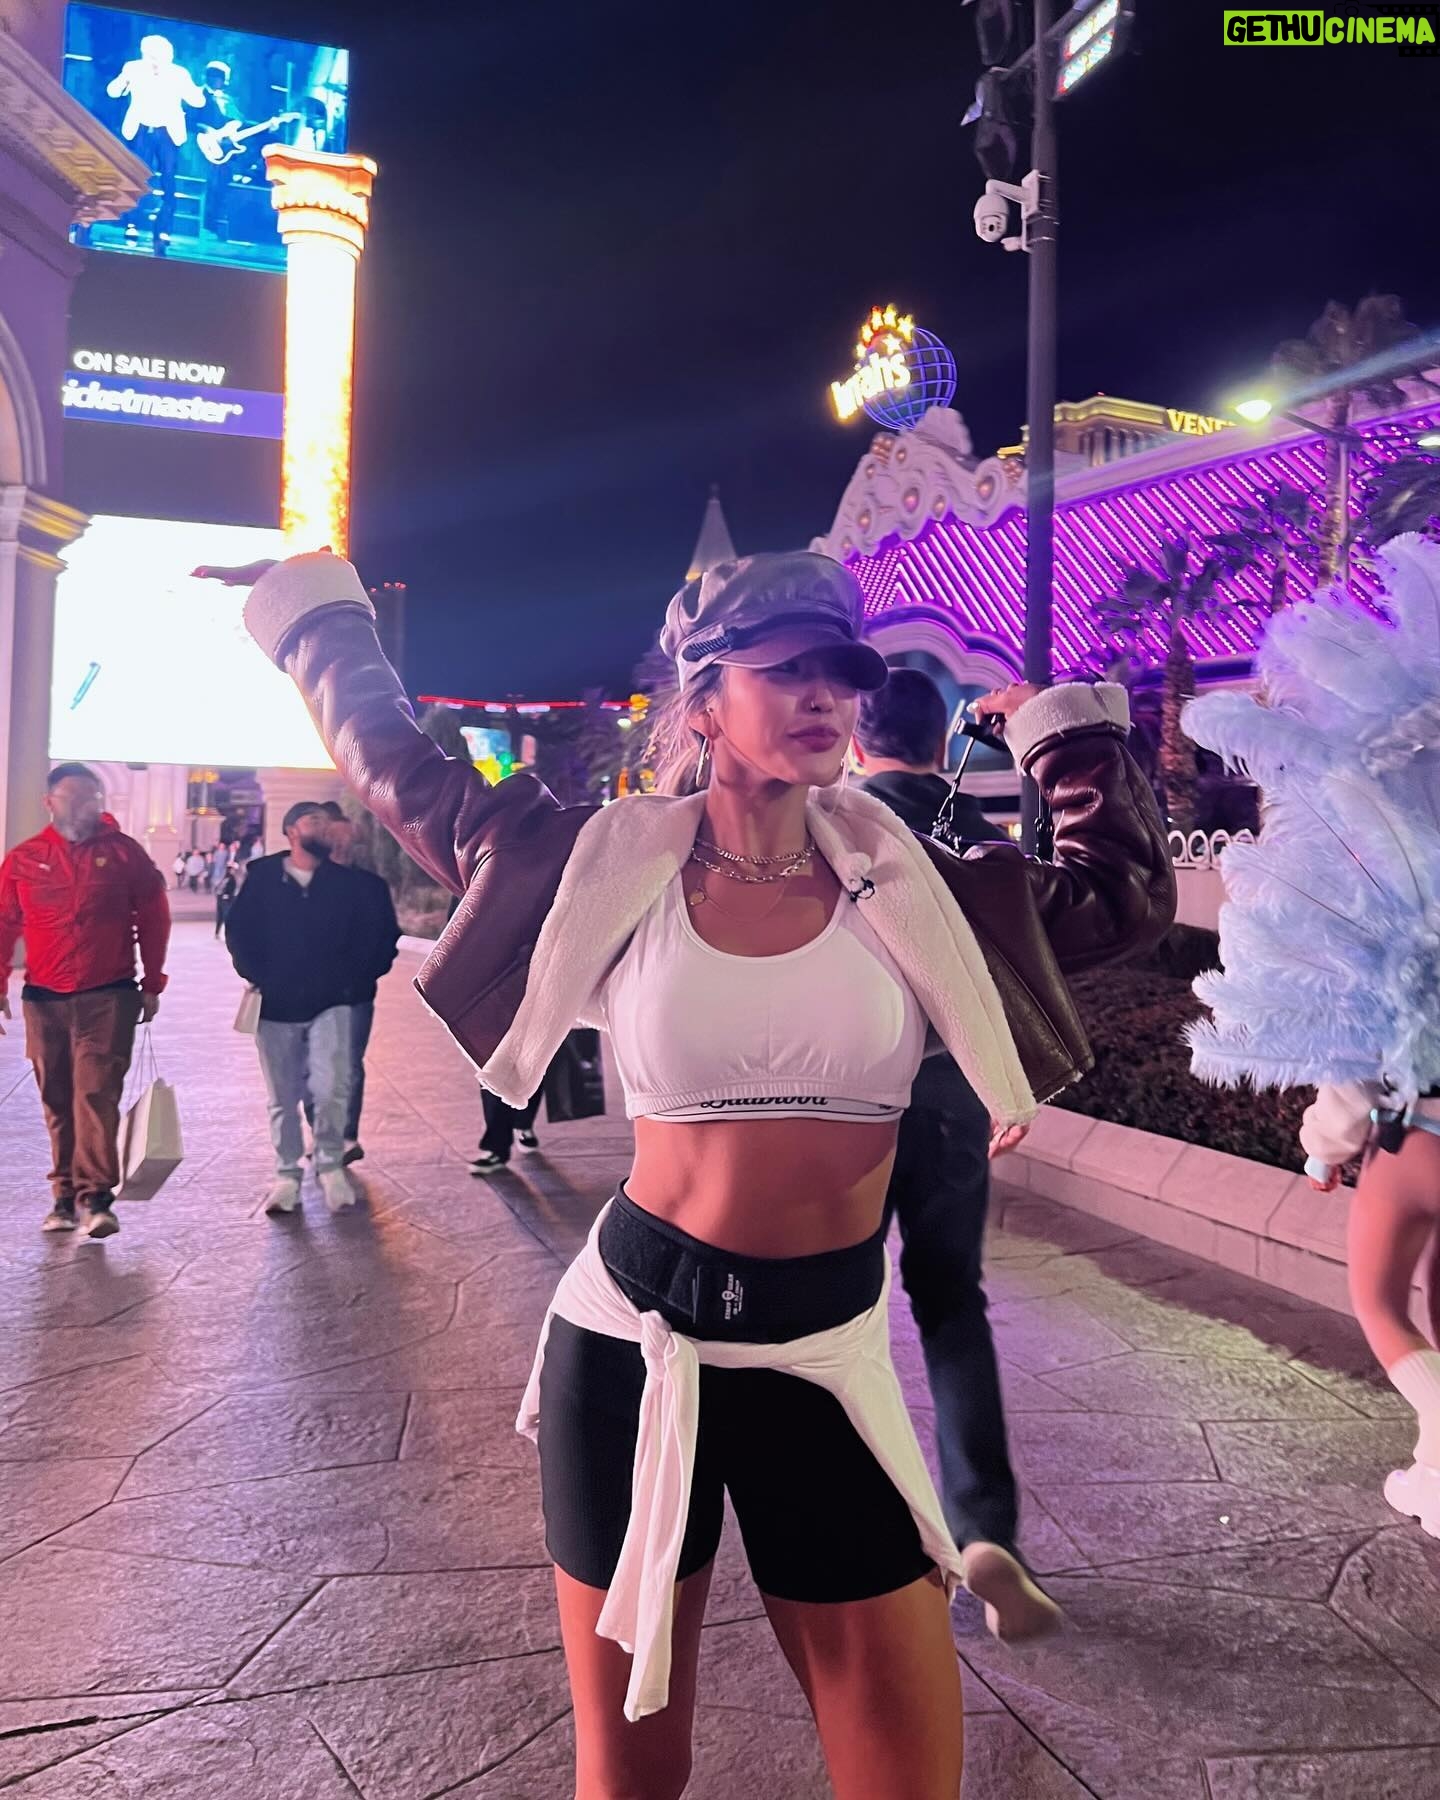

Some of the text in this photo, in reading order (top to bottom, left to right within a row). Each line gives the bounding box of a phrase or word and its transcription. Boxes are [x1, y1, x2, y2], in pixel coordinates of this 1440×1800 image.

[73, 350, 226, 385] ON SALE NOW
[62, 378, 233, 424] icketmaster
